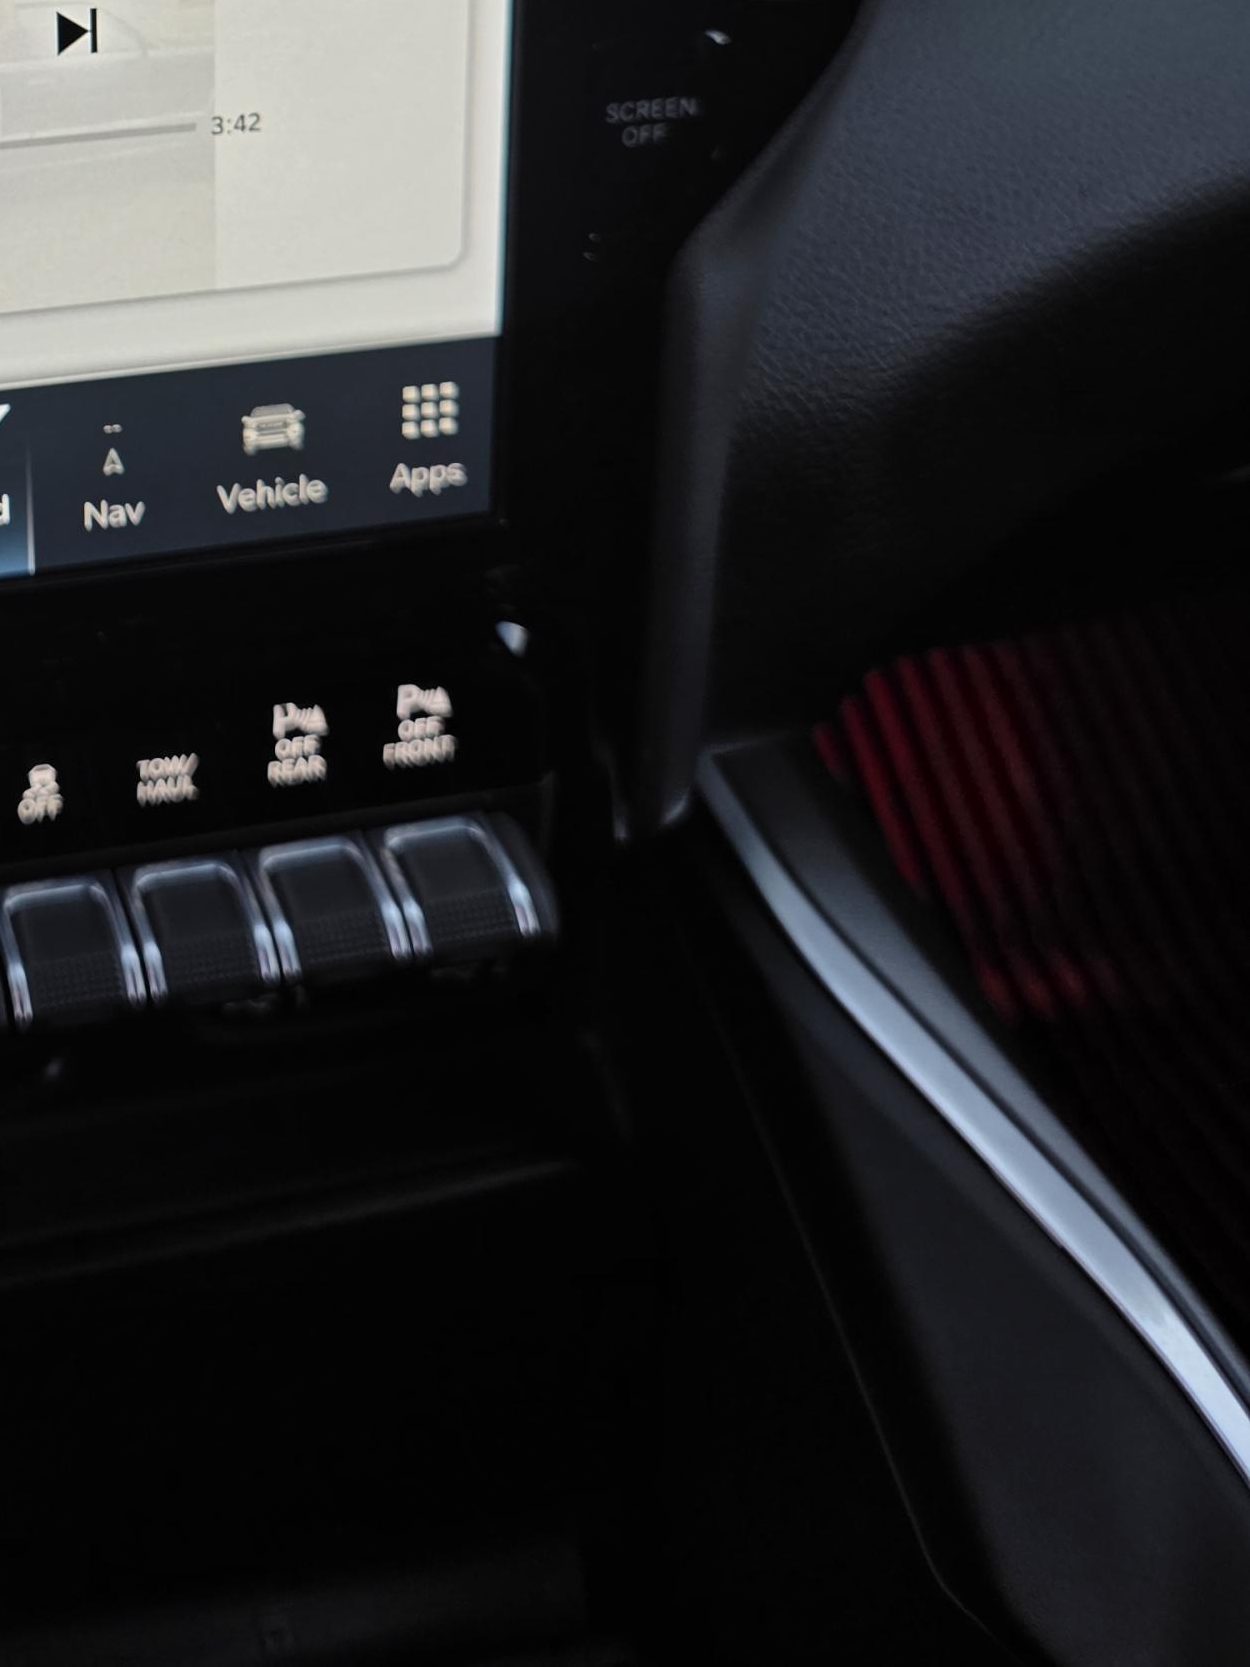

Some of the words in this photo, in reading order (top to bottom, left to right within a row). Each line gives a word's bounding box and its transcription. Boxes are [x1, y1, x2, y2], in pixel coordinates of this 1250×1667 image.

[605, 97, 700, 122] SCREEN
[211, 112, 262, 136] 3:42
[621, 123, 666, 148] OFF
[390, 462, 468, 497] Apps
[216, 474, 330, 514] Vehicle
[83, 500, 146, 532] Nav
